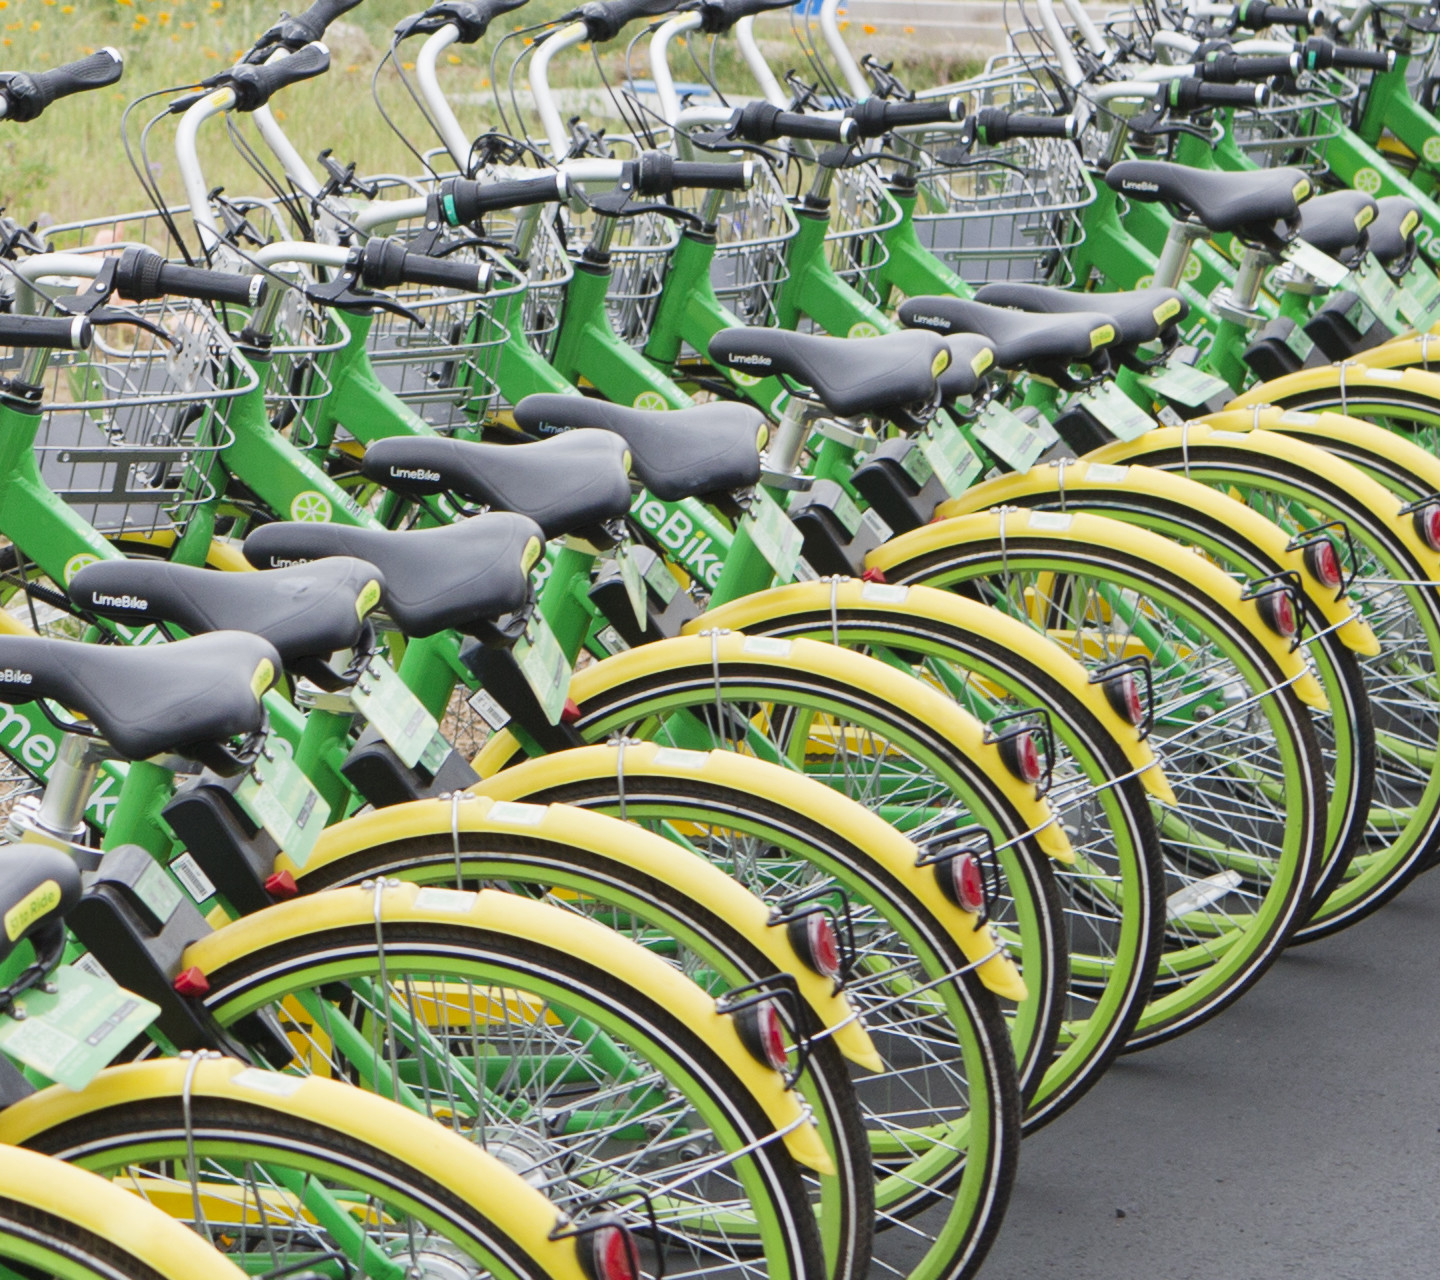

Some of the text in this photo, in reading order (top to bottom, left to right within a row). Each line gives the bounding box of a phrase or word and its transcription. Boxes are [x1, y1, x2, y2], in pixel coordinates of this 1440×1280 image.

[913, 314, 951, 328] LimeBike
[729, 353, 772, 366] LimeBike
[390, 466, 440, 481] LimeBike
[92, 591, 148, 610] LimeBike
